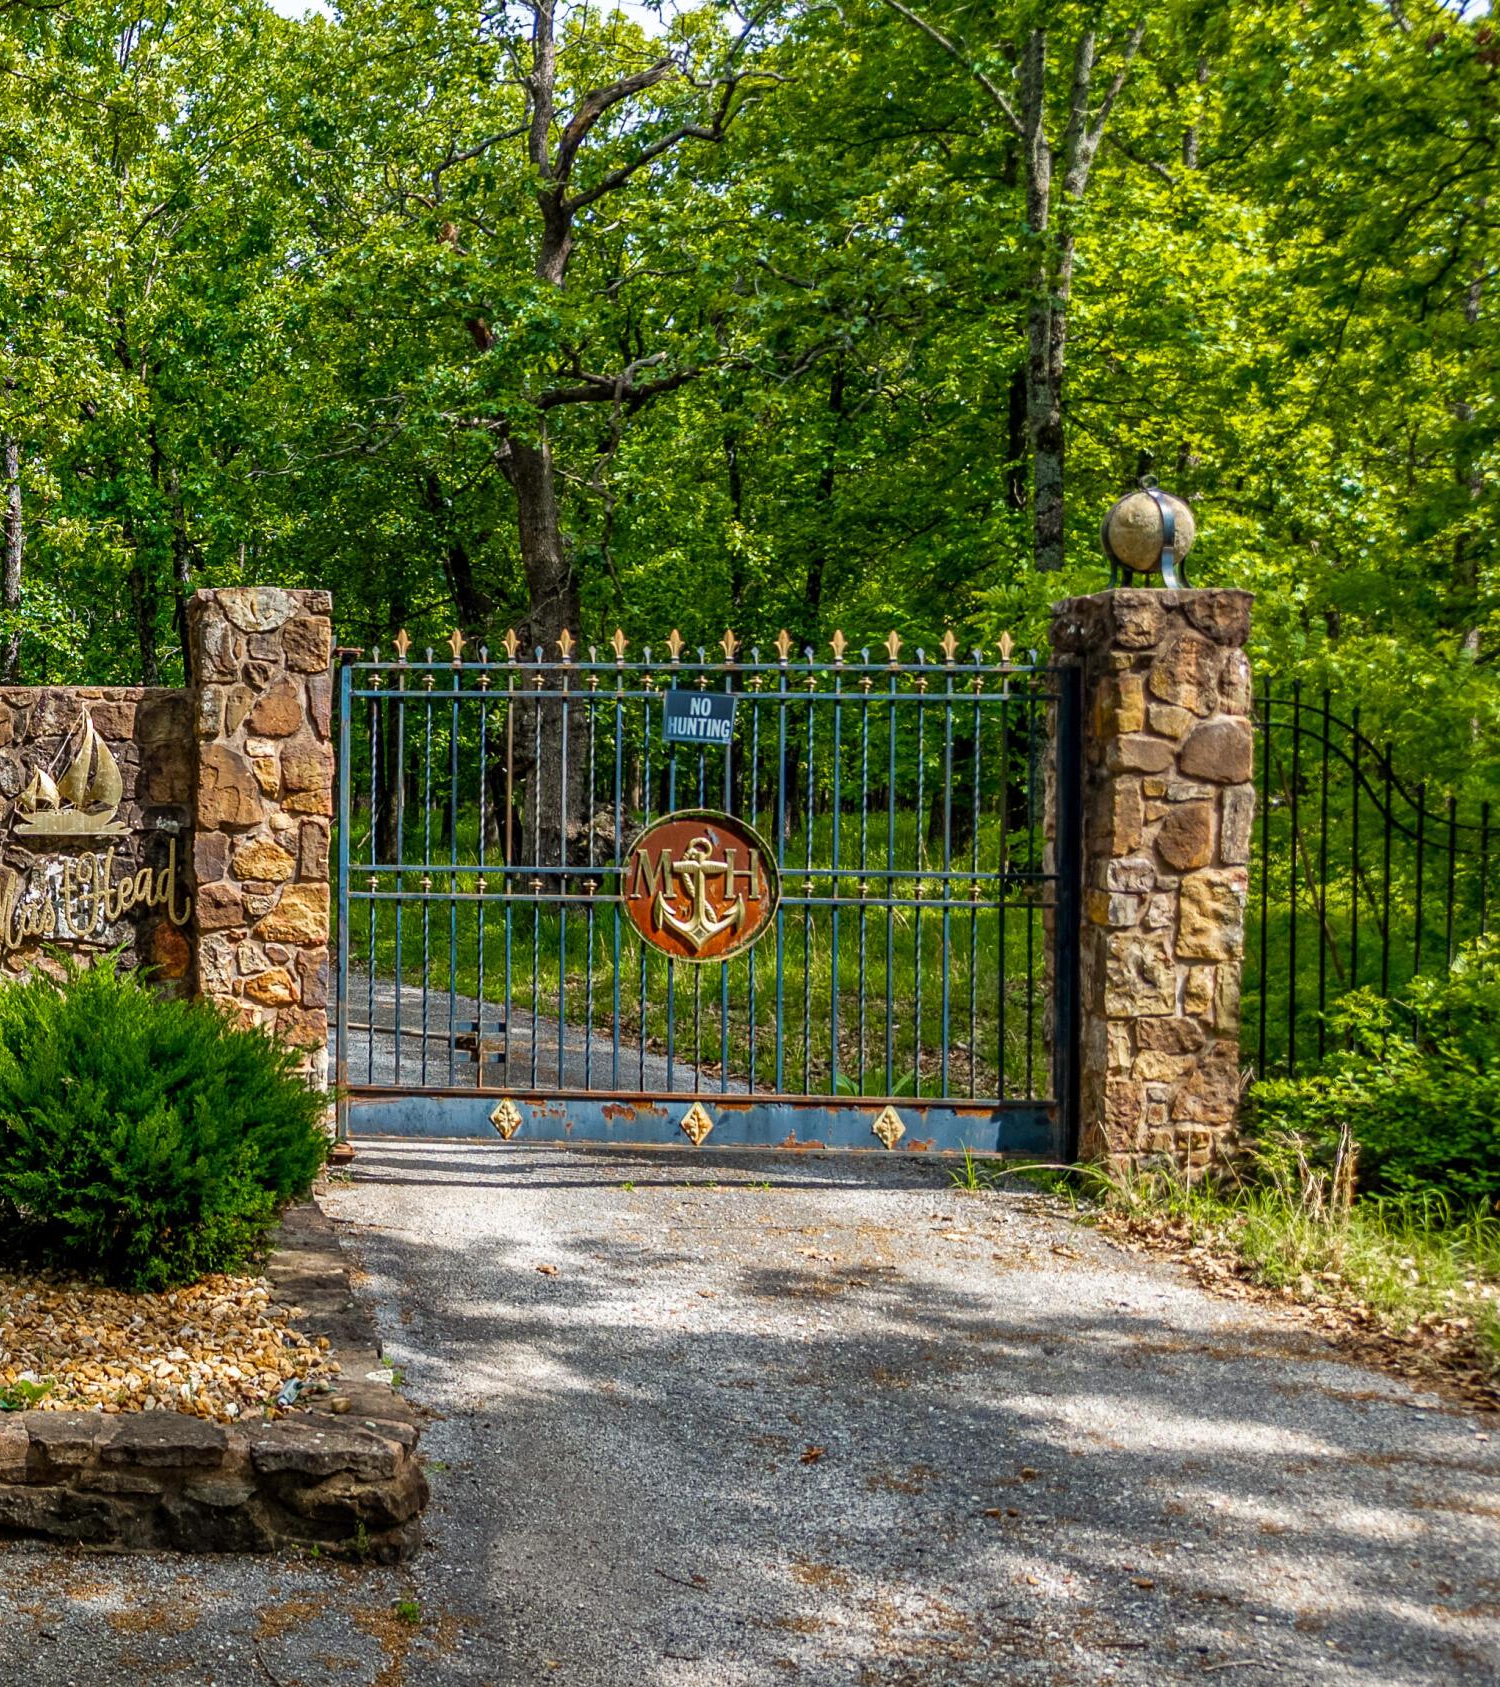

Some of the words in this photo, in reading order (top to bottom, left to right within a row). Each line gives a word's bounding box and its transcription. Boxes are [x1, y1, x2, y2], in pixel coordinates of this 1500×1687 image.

[690, 697, 712, 717] NO
[667, 716, 731, 738] HUNTING
[630, 848, 677, 899] M
[724, 848, 761, 900] H
